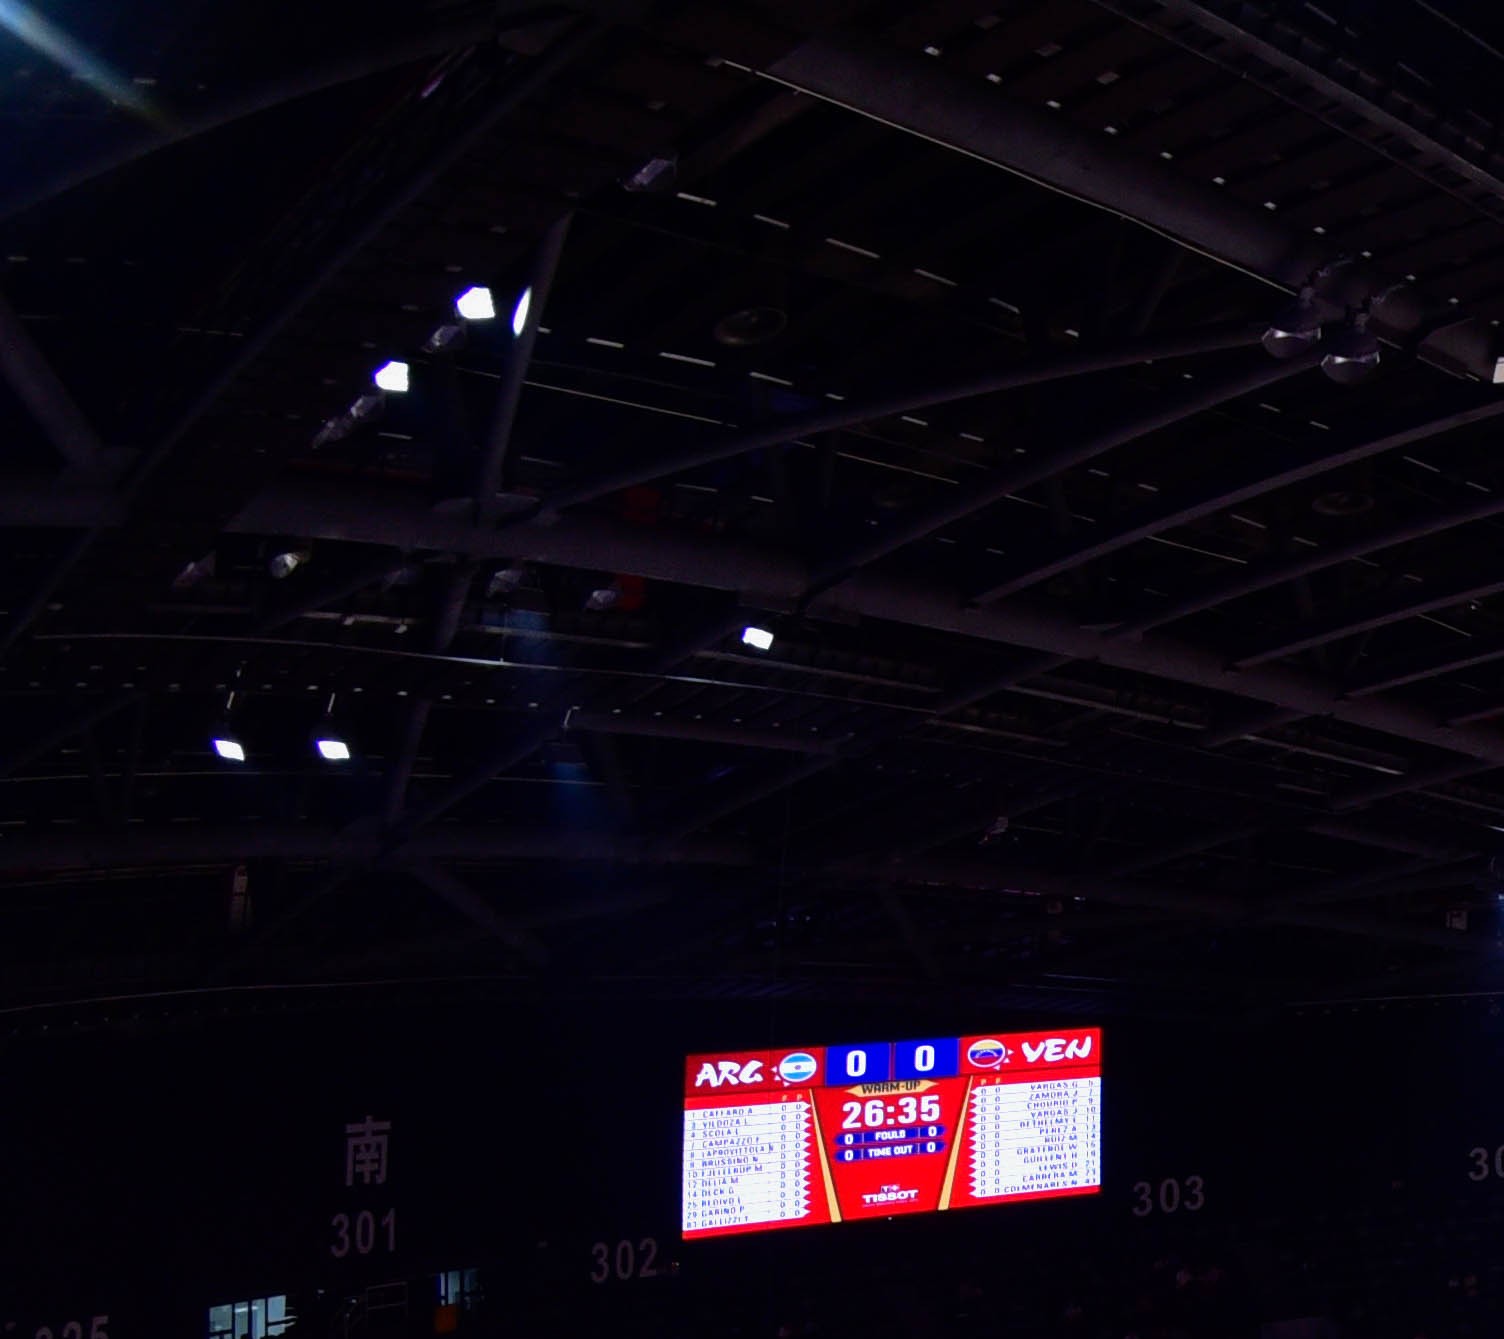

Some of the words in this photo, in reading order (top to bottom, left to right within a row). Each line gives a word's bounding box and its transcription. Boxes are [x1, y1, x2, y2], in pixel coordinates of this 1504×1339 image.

[695, 1060, 764, 1087] ARG
[846, 1051, 866, 1076] 0
[915, 1045, 934, 1071] 0
[1021, 1036, 1092, 1063] VEN
[862, 1081, 921, 1094] WARM-UP
[842, 1096, 940, 1128] 26:35
[346, 1115, 391, 1186] 南
[868, 1146, 889, 1158] TIME
[891, 1145, 913, 1156] OUT
[875, 1130, 906, 1141] FOULS
[863, 1189, 918, 1204] TISSOT
[1133, 1175, 1204, 1216] 303
[331, 1208, 395, 1257] 301
[591, 1237, 658, 1283] 302
